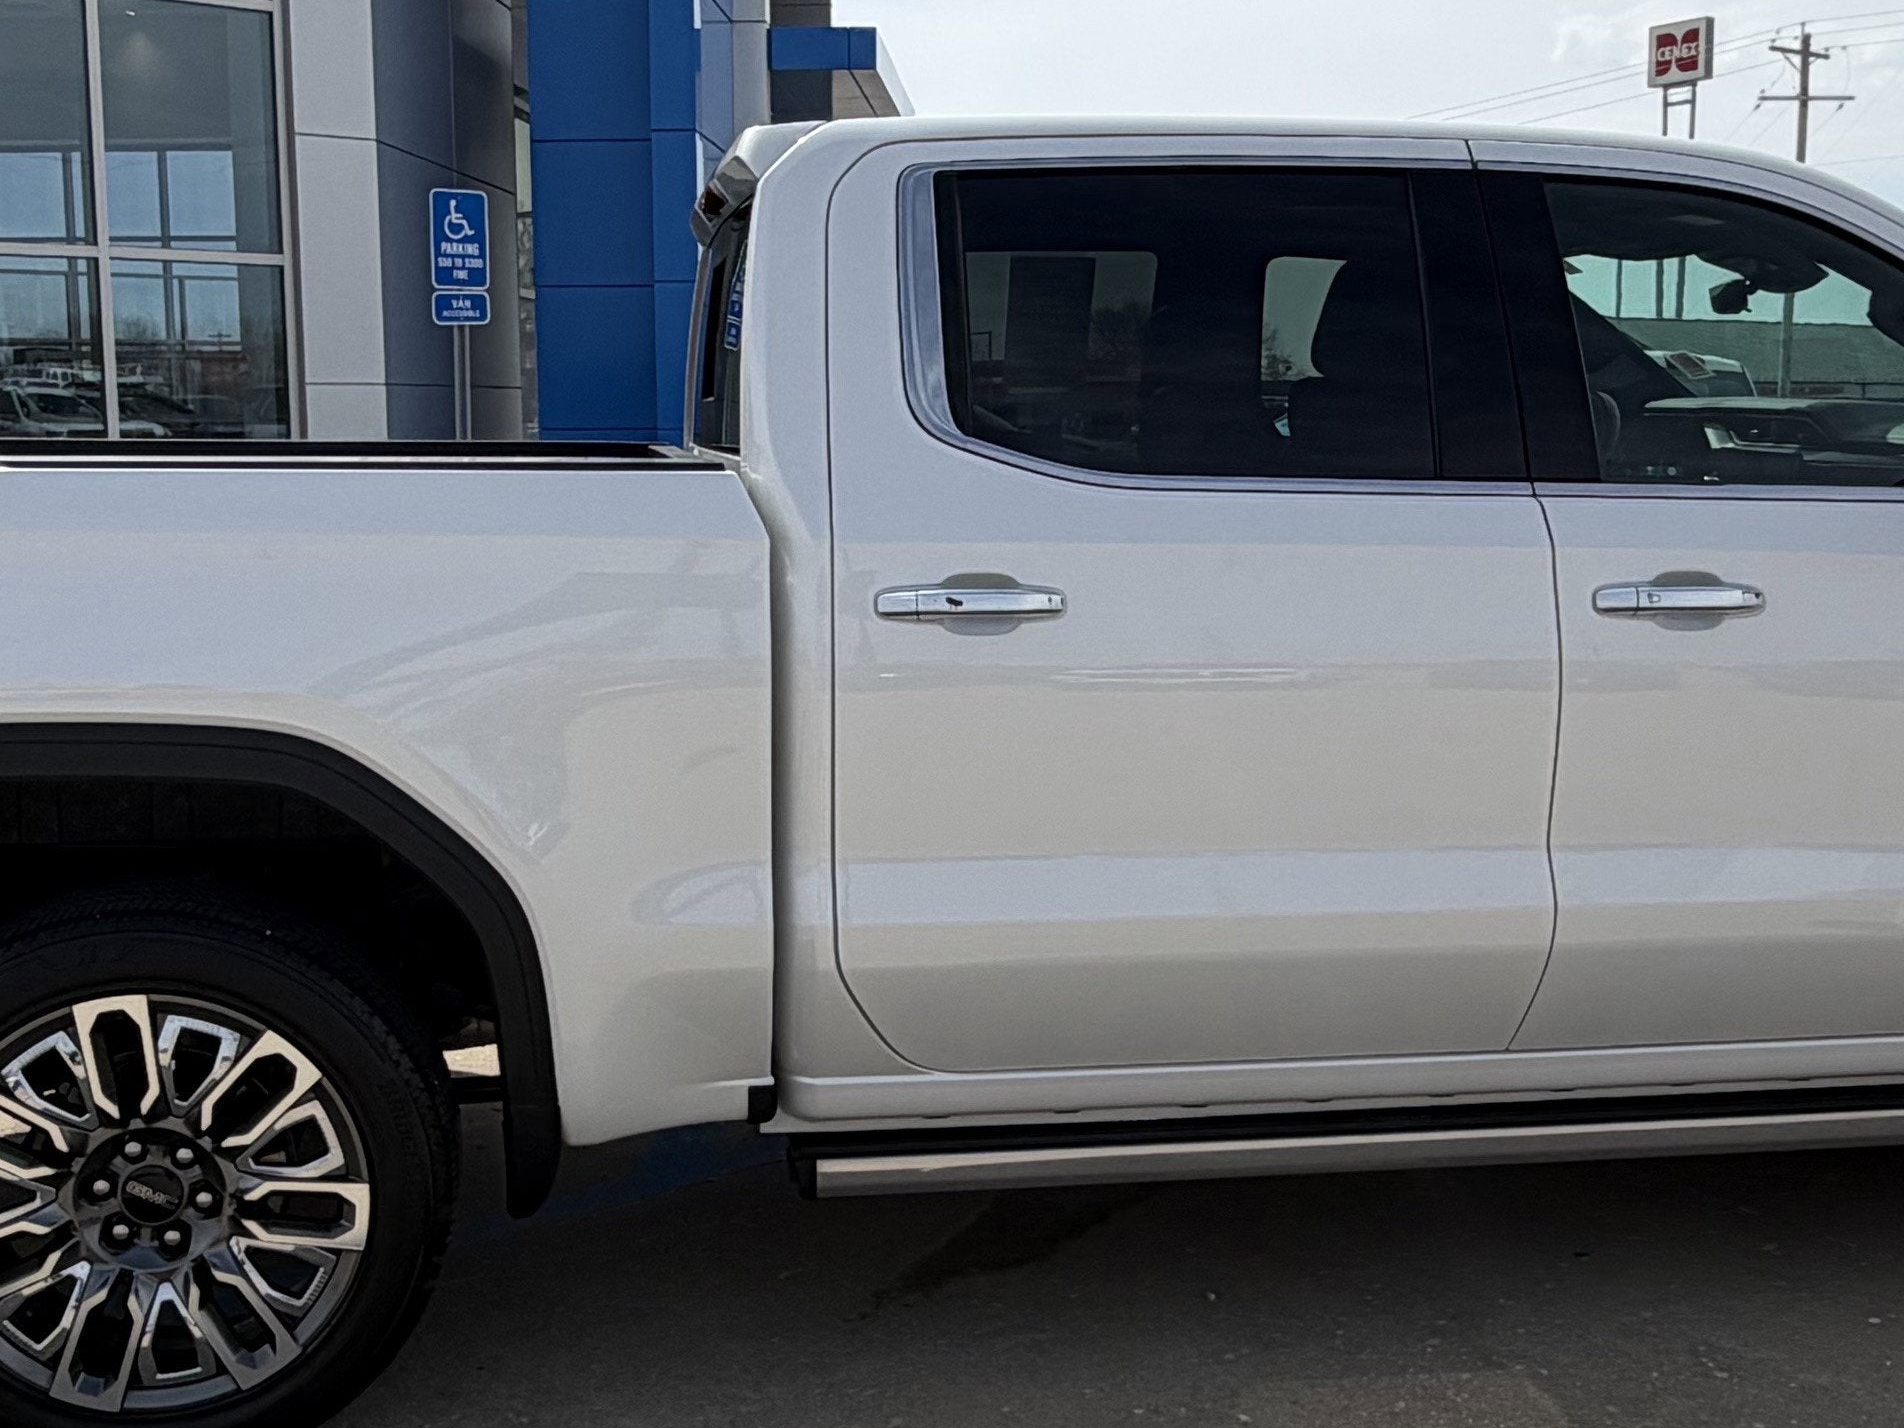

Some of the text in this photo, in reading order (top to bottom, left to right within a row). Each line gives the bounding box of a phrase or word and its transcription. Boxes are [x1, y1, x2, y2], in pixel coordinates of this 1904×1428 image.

[1656, 42, 1701, 62] CENEX
[440, 241, 480, 256] PARKING
[451, 299, 472, 308] VAN
[126, 1181, 178, 1210] GMC
